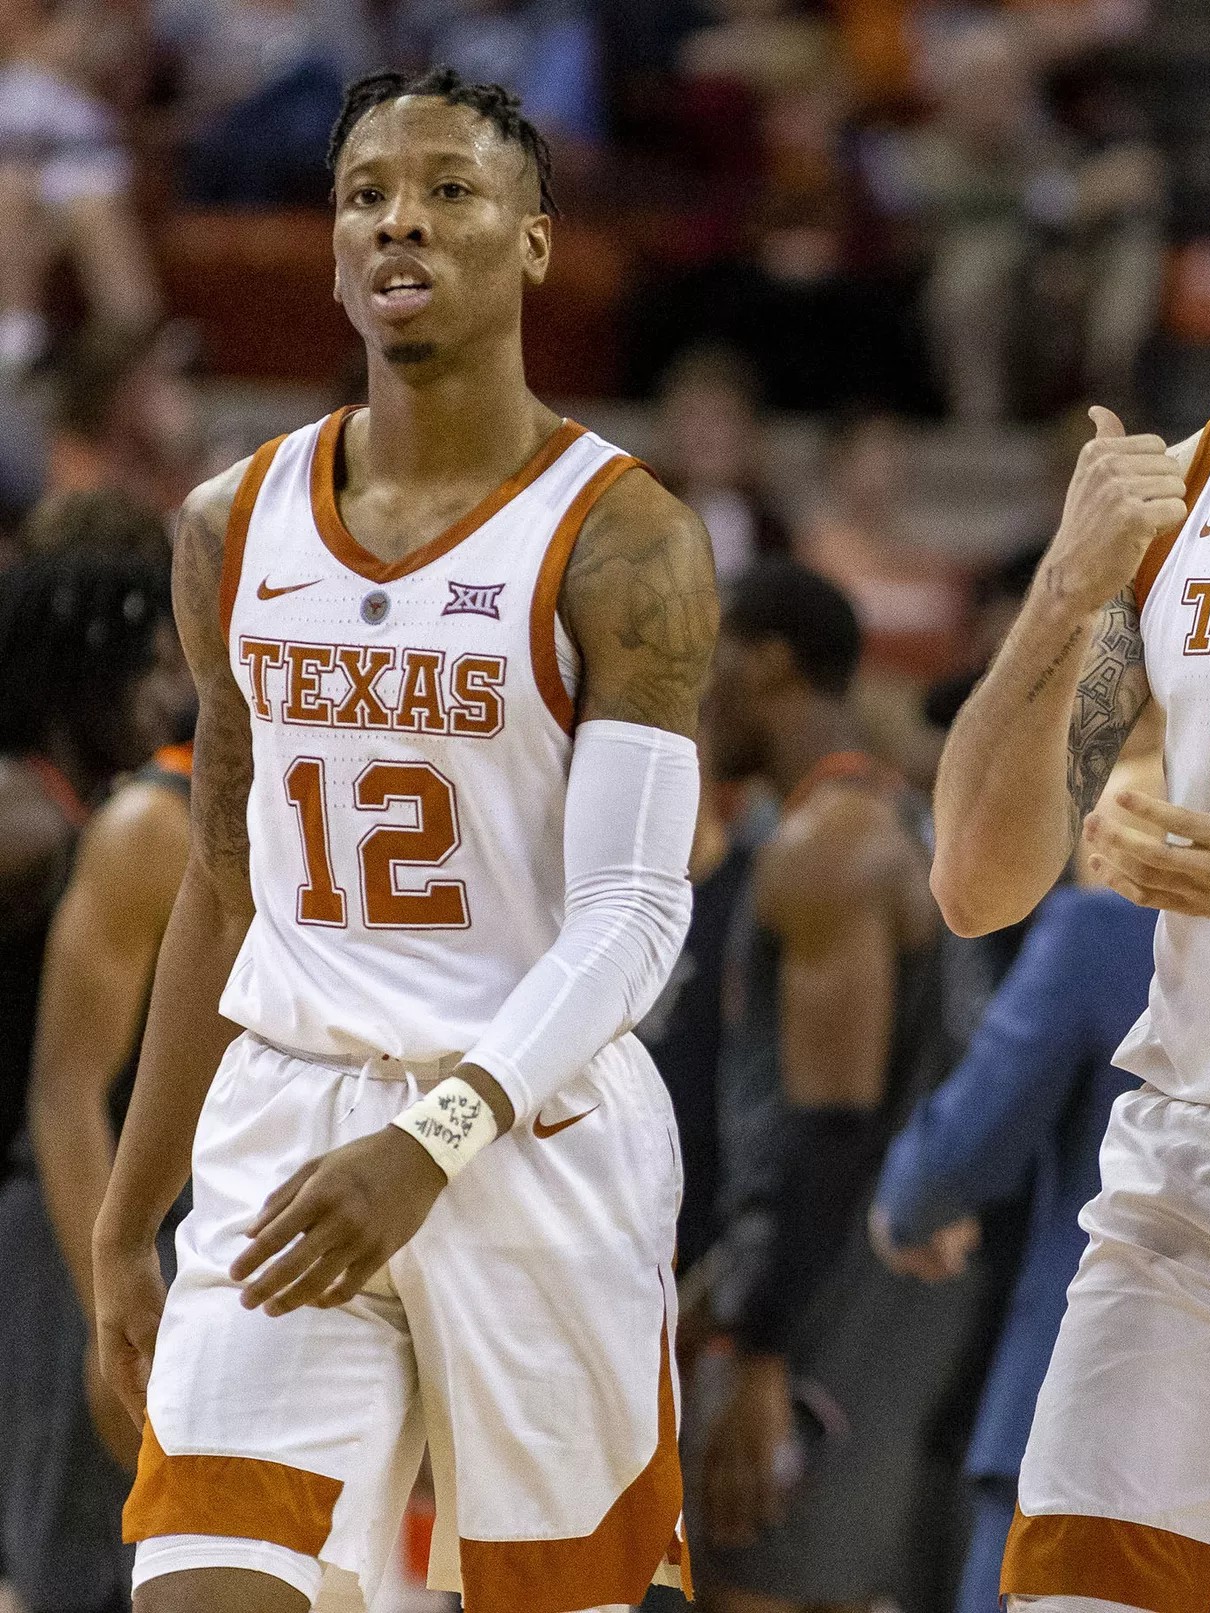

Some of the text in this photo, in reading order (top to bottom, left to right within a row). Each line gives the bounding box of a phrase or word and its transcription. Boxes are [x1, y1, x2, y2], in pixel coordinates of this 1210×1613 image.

[443, 582, 503, 619] XII
[239, 636, 507, 739] TEXAS
[284, 756, 471, 930] 12
